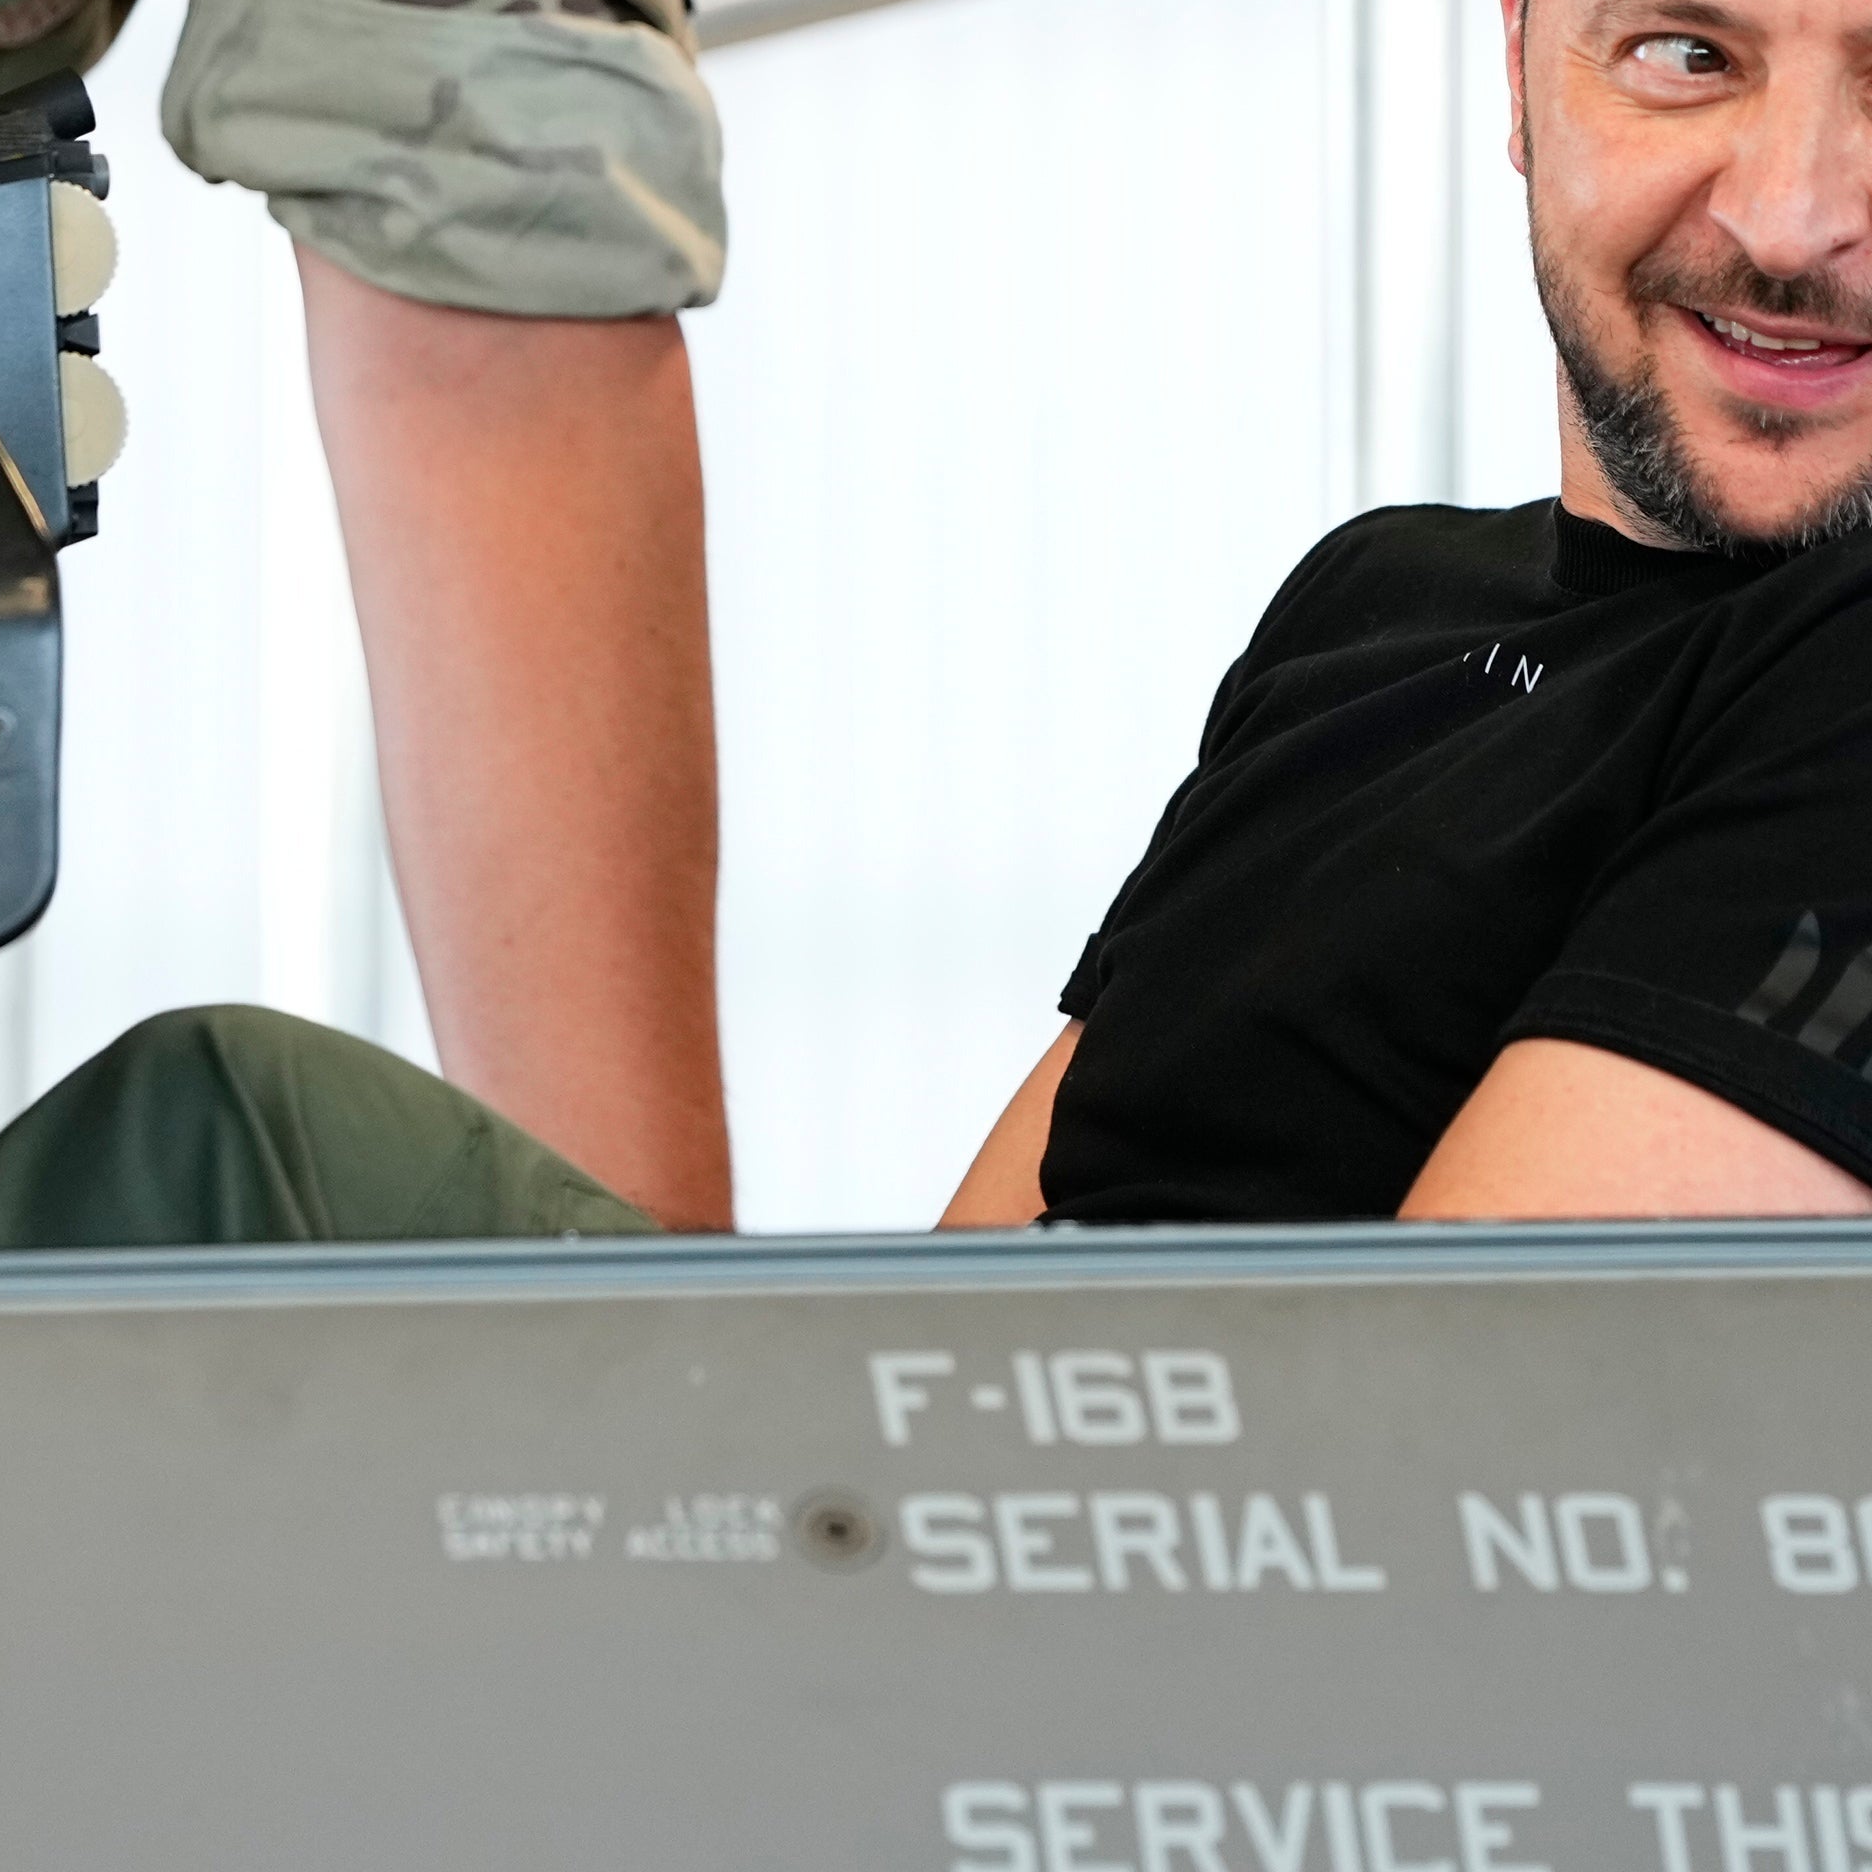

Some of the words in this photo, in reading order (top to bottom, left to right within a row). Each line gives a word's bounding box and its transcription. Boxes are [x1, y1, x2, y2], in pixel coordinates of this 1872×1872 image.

[868, 1349, 1240, 1447] F-16B
[898, 1490, 1385, 1594] SERIAL
[942, 1779, 1555, 1872] SERVICE
